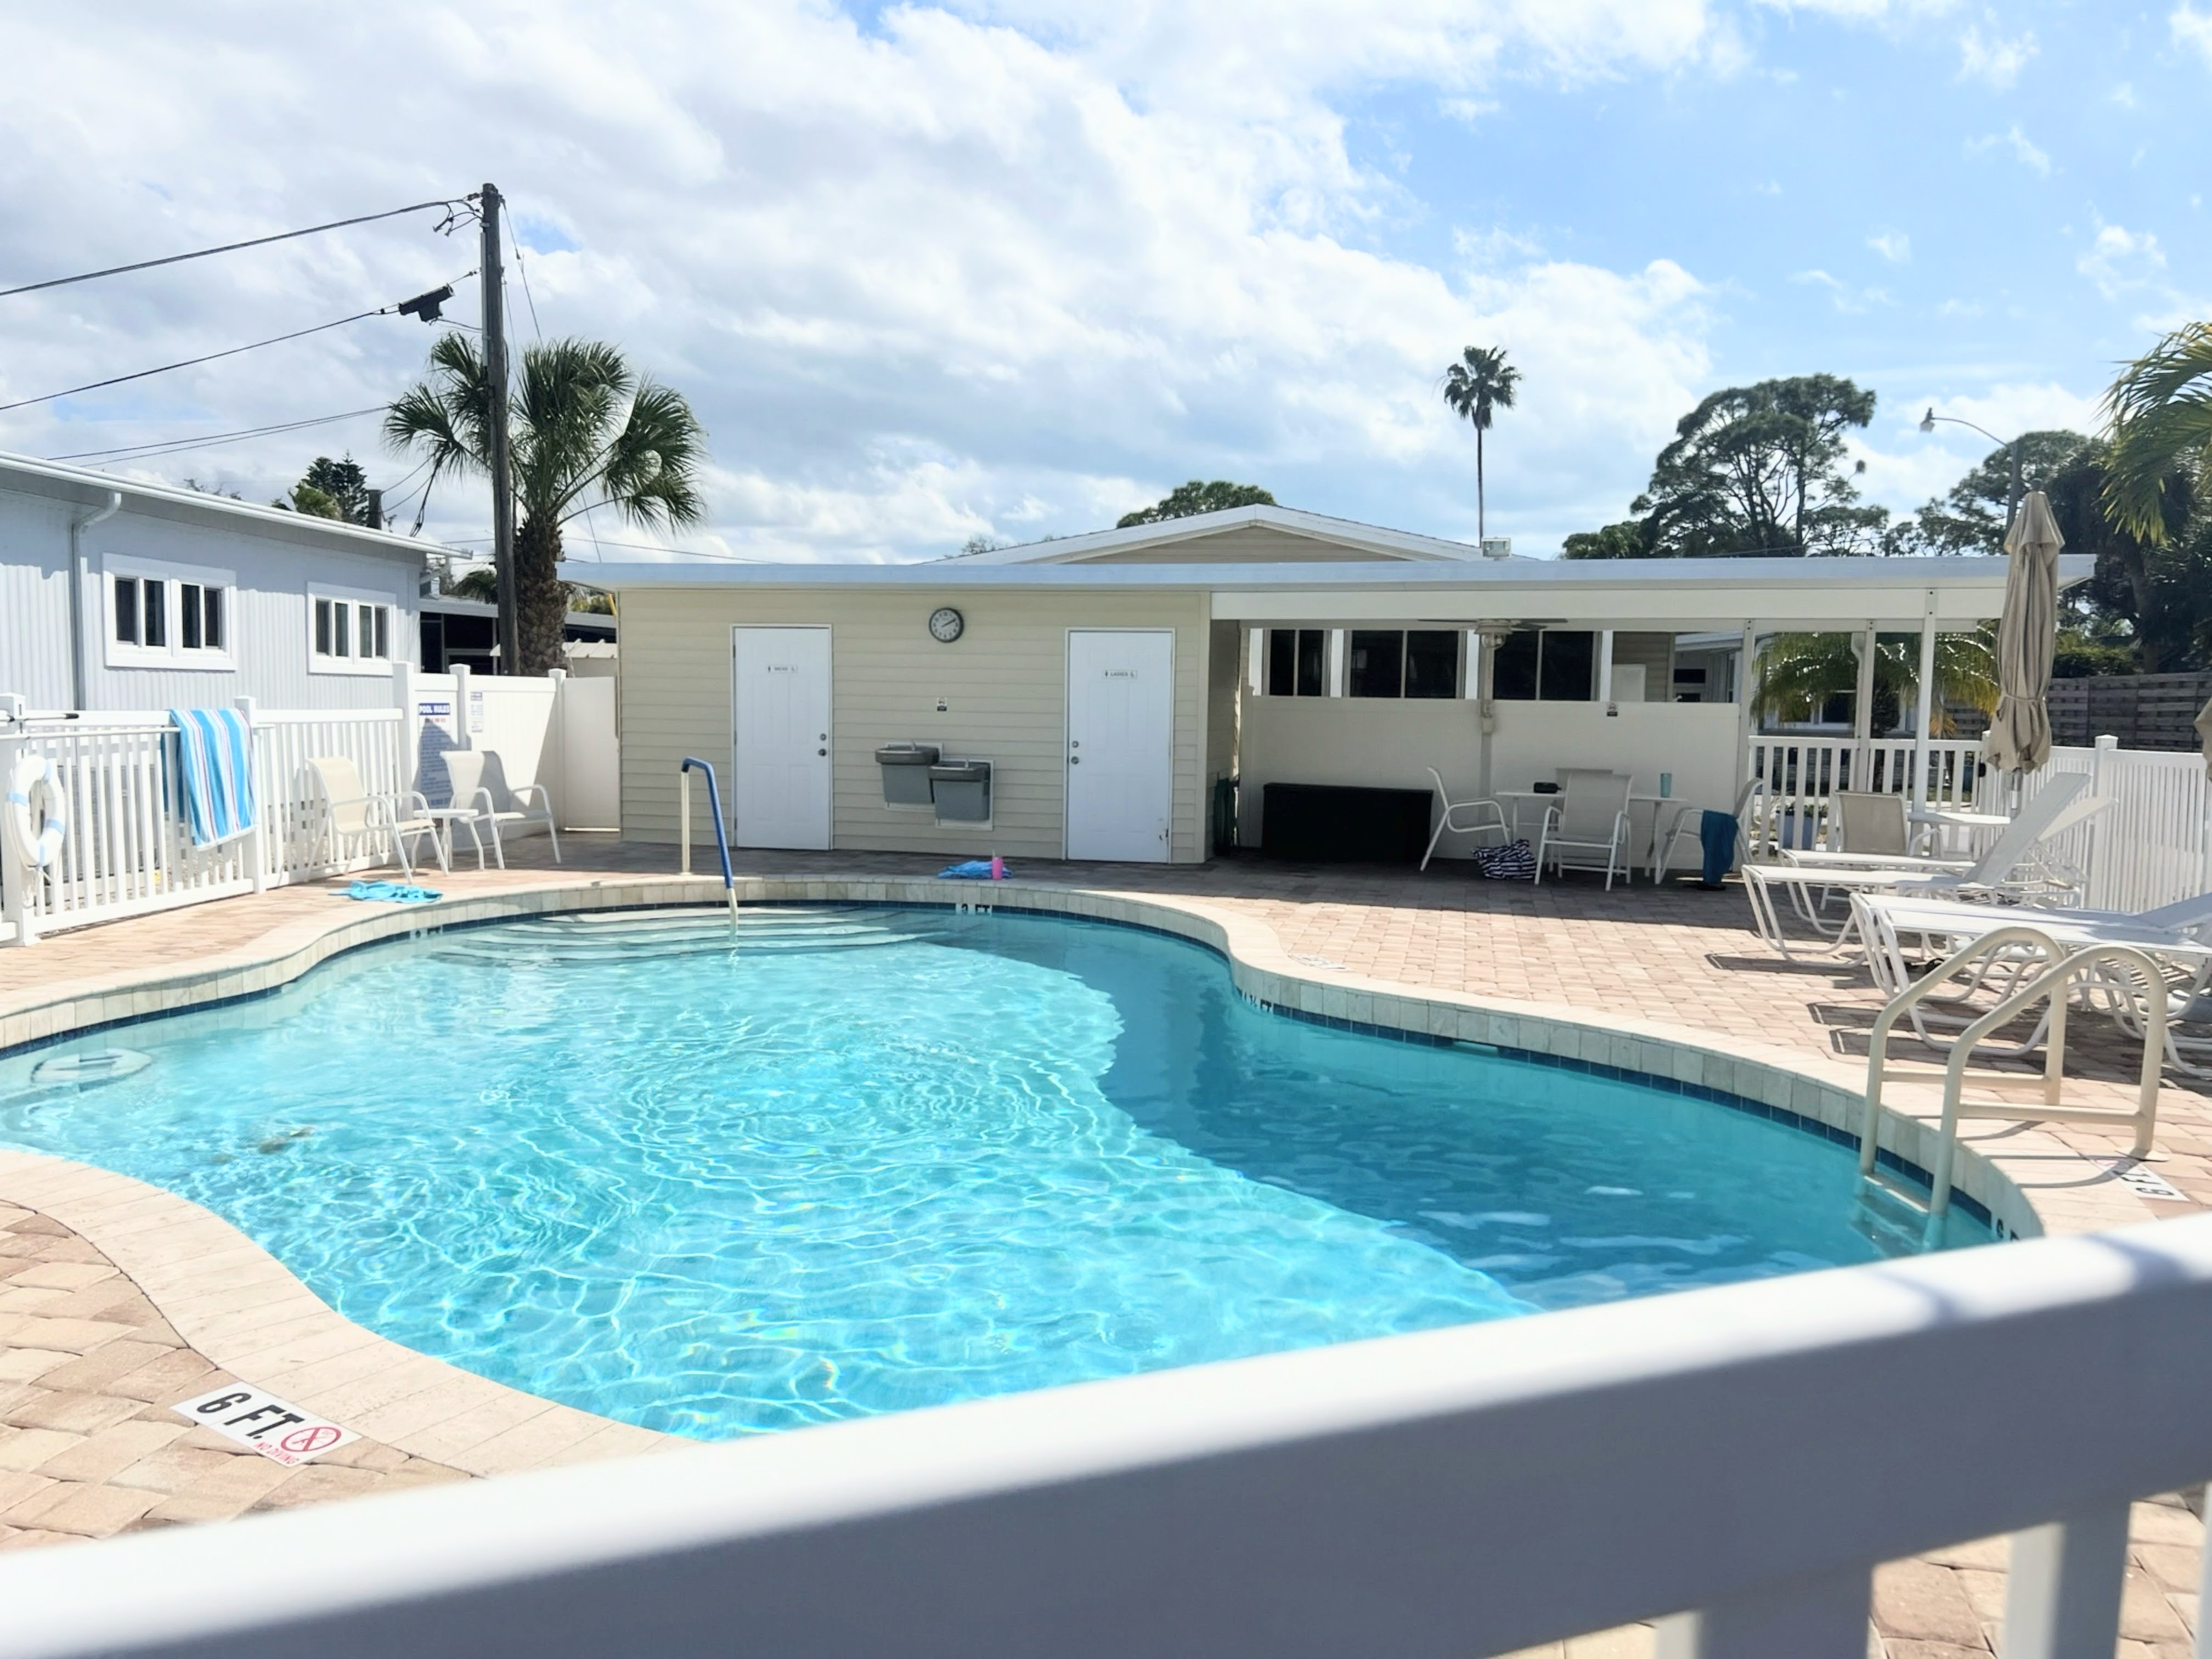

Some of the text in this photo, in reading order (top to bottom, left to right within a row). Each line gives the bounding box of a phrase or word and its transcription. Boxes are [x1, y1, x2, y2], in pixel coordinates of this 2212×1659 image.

[419, 704, 449, 714] POOL RULES
[197, 1392, 306, 1439] 6 FT.
[254, 1442, 300, 1464] NO DIVING
